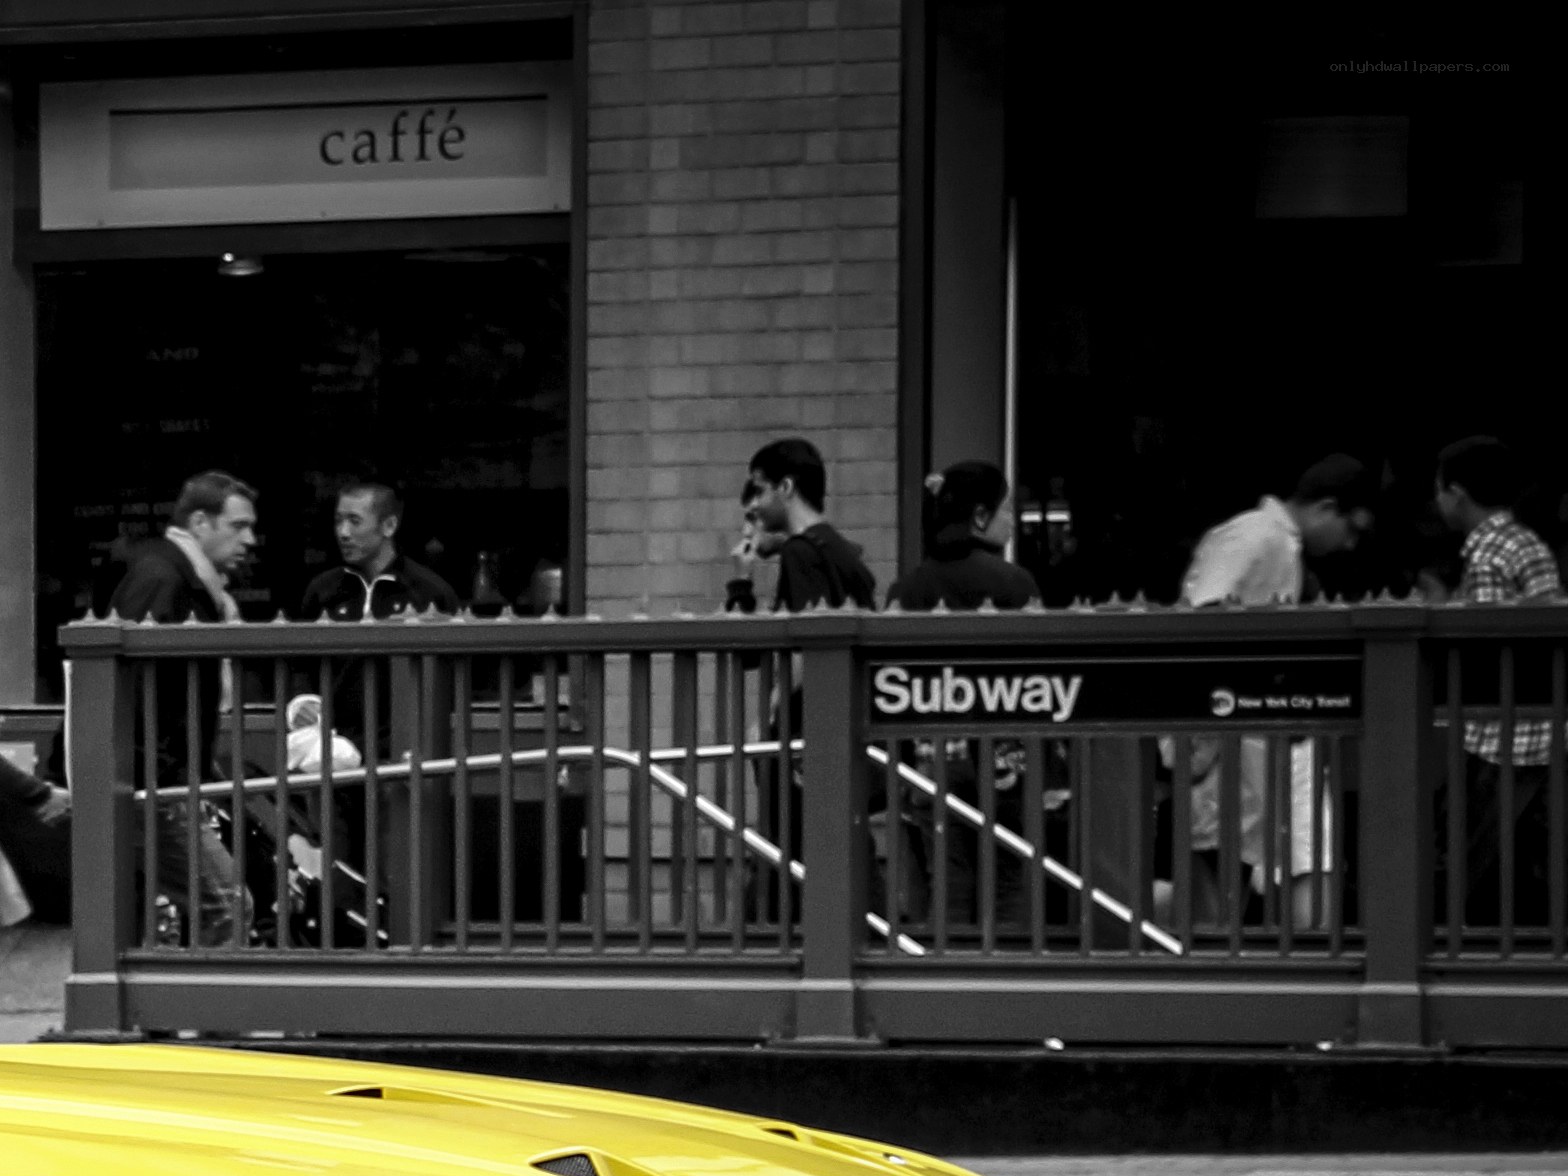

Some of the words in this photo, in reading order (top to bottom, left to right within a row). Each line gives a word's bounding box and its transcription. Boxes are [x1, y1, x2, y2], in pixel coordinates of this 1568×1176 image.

[319, 107, 466, 166] caffé
[873, 666, 1083, 723] Subway
[1237, 696, 1263, 708] New
[1265, 695, 1288, 708] York
[1290, 694, 1313, 710] City
[1316, 694, 1351, 708] Transit
